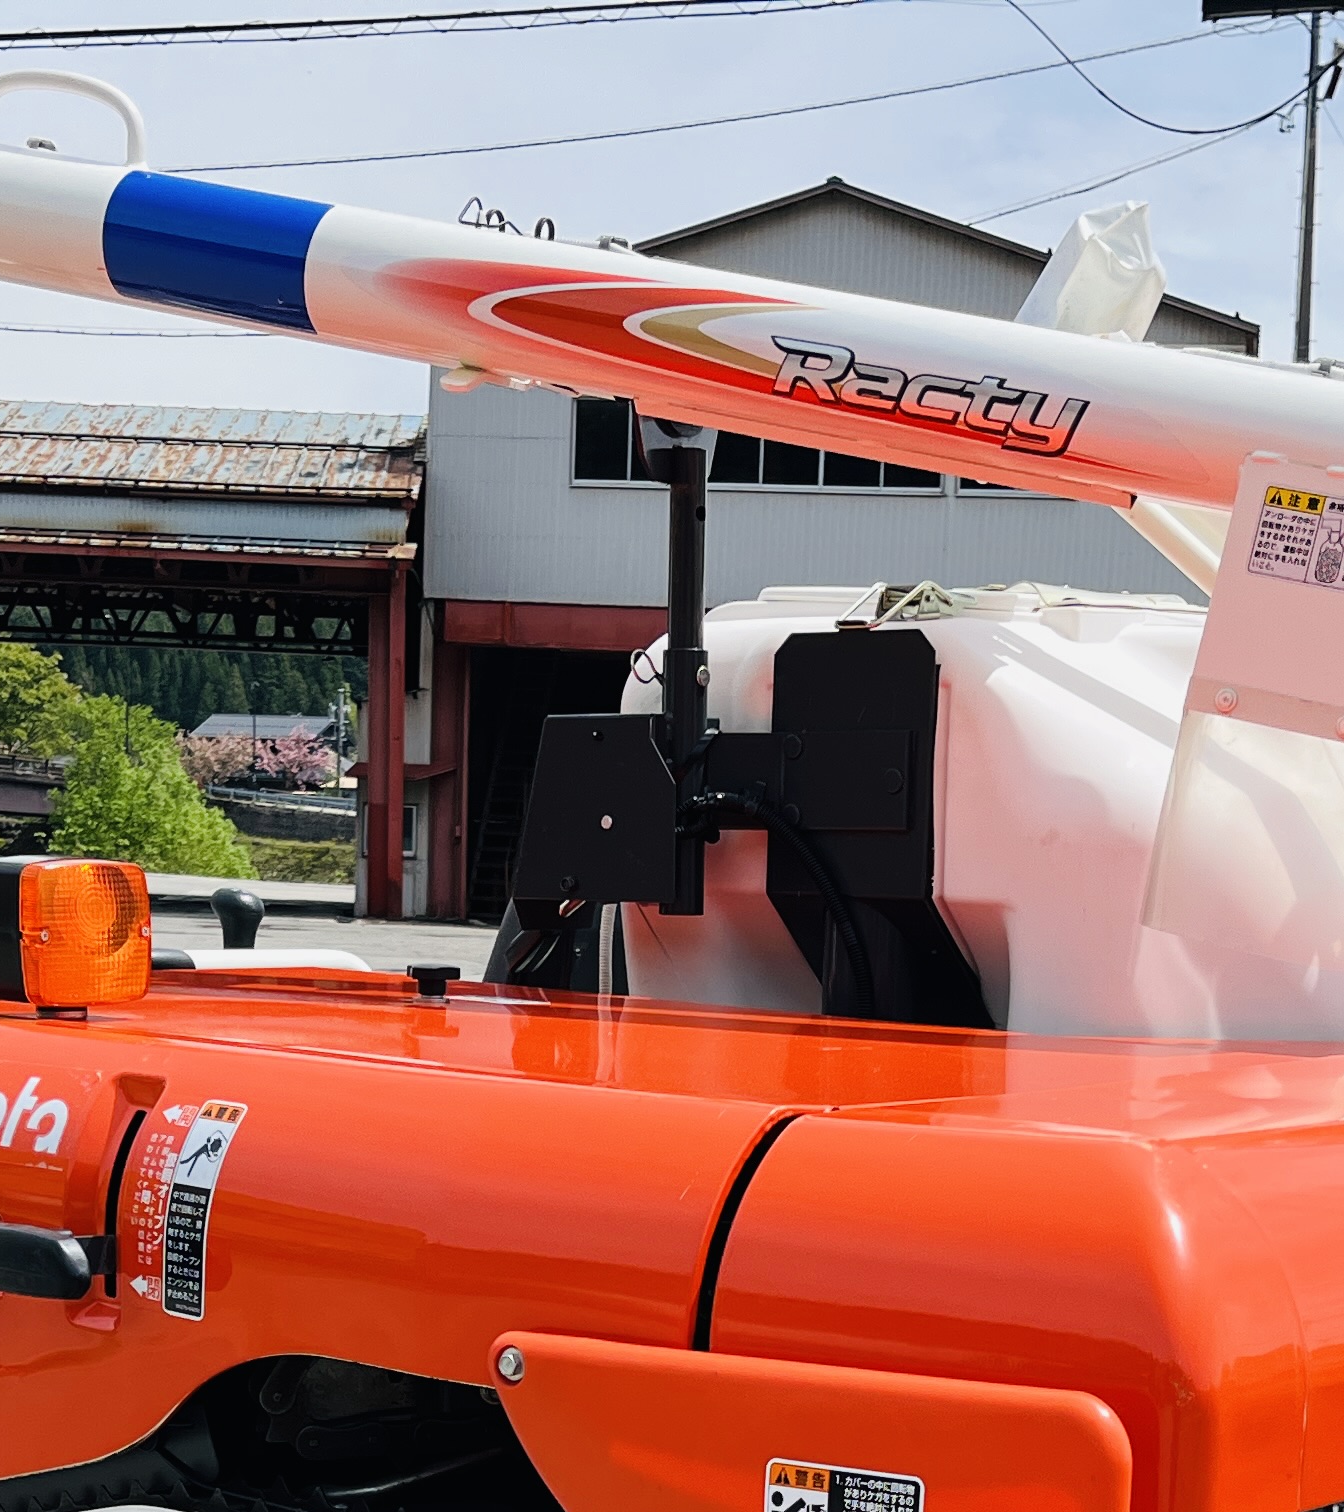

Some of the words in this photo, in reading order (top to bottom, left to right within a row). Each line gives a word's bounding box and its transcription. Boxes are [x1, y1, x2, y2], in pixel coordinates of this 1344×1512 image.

[771, 335, 1090, 457] Racty
[1288, 493, 1320, 511] 注意
[153, 1152, 178, 1244] オープン
[166, 1251, 200, 1266] オープン
